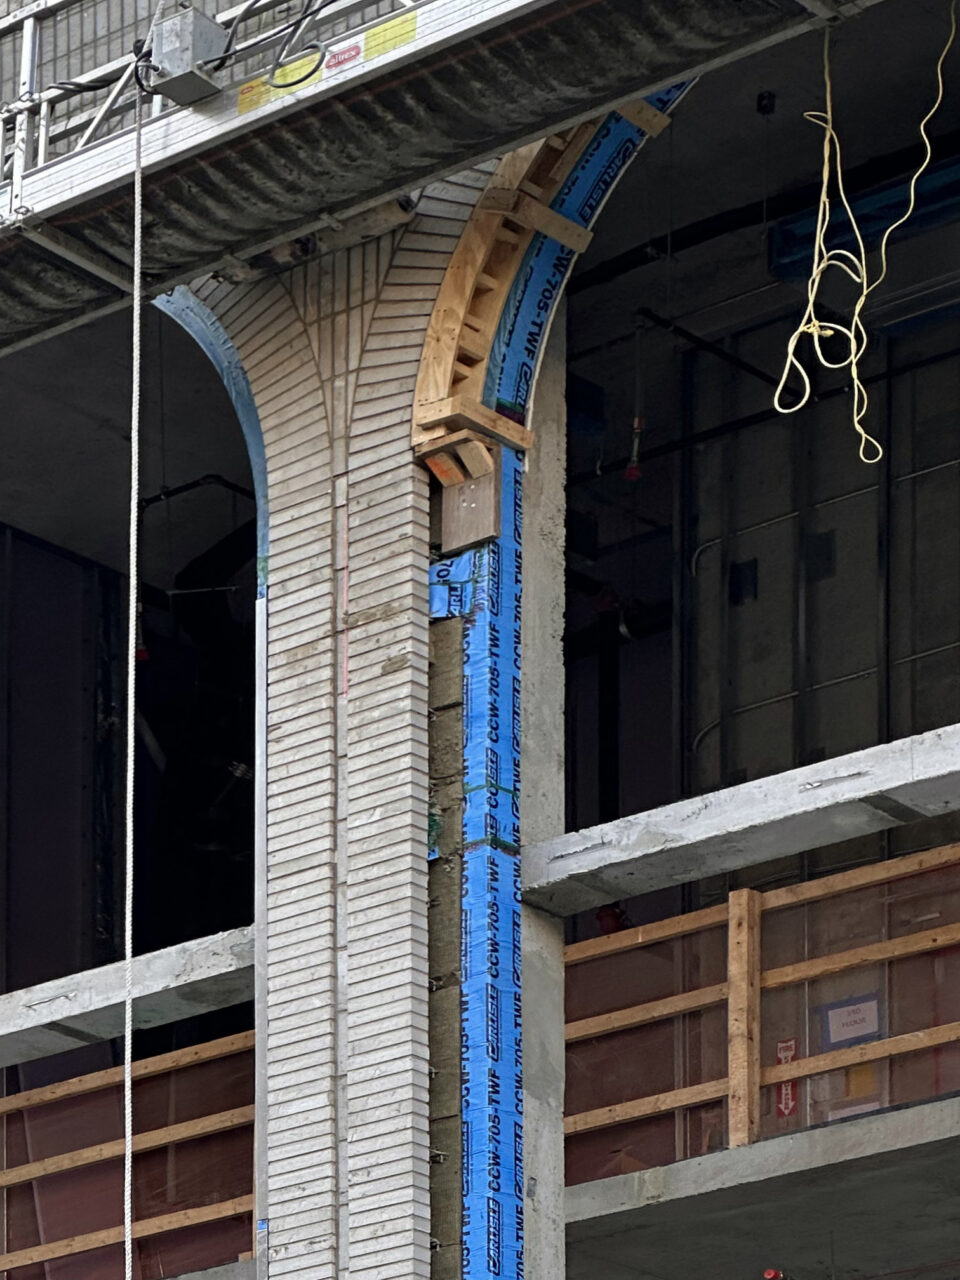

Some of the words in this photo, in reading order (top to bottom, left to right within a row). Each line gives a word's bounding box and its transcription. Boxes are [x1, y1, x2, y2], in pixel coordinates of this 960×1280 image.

[487, 621, 500, 745] CCW-705-TWF
[487, 855, 500, 980] CCW-705-TWF
[486, 983, 500, 1064] CARLISLE
[487, 1066, 501, 1194] CCW-705-TWF
[486, 1197, 501, 1277] CARLISLE
